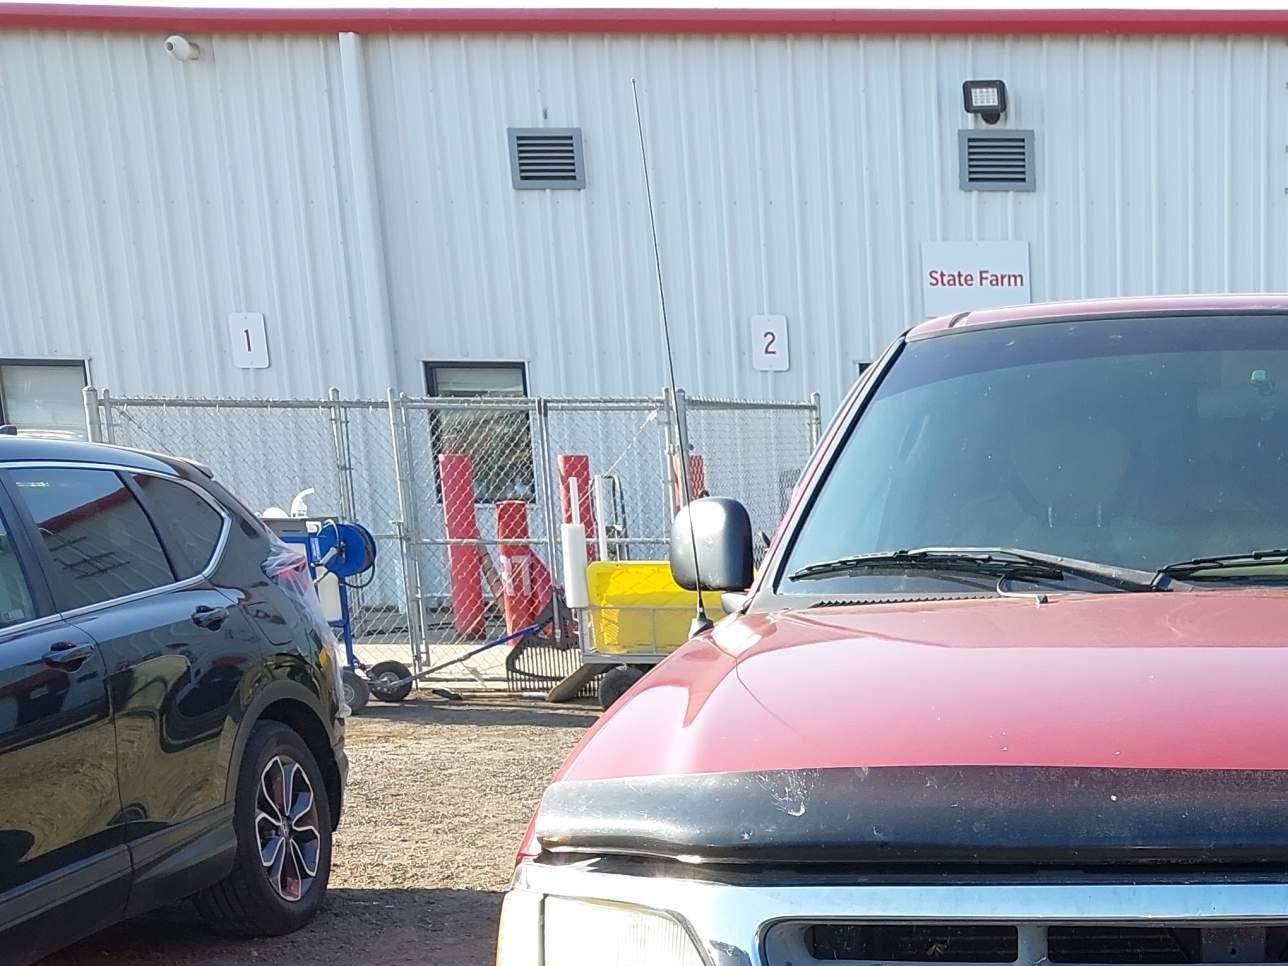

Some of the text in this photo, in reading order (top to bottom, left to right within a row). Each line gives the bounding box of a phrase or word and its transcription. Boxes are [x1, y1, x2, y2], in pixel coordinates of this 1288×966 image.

[928, 270, 1024, 287] State Farm
[244, 328, 252, 353] 1
[763, 331, 777, 355] 2
